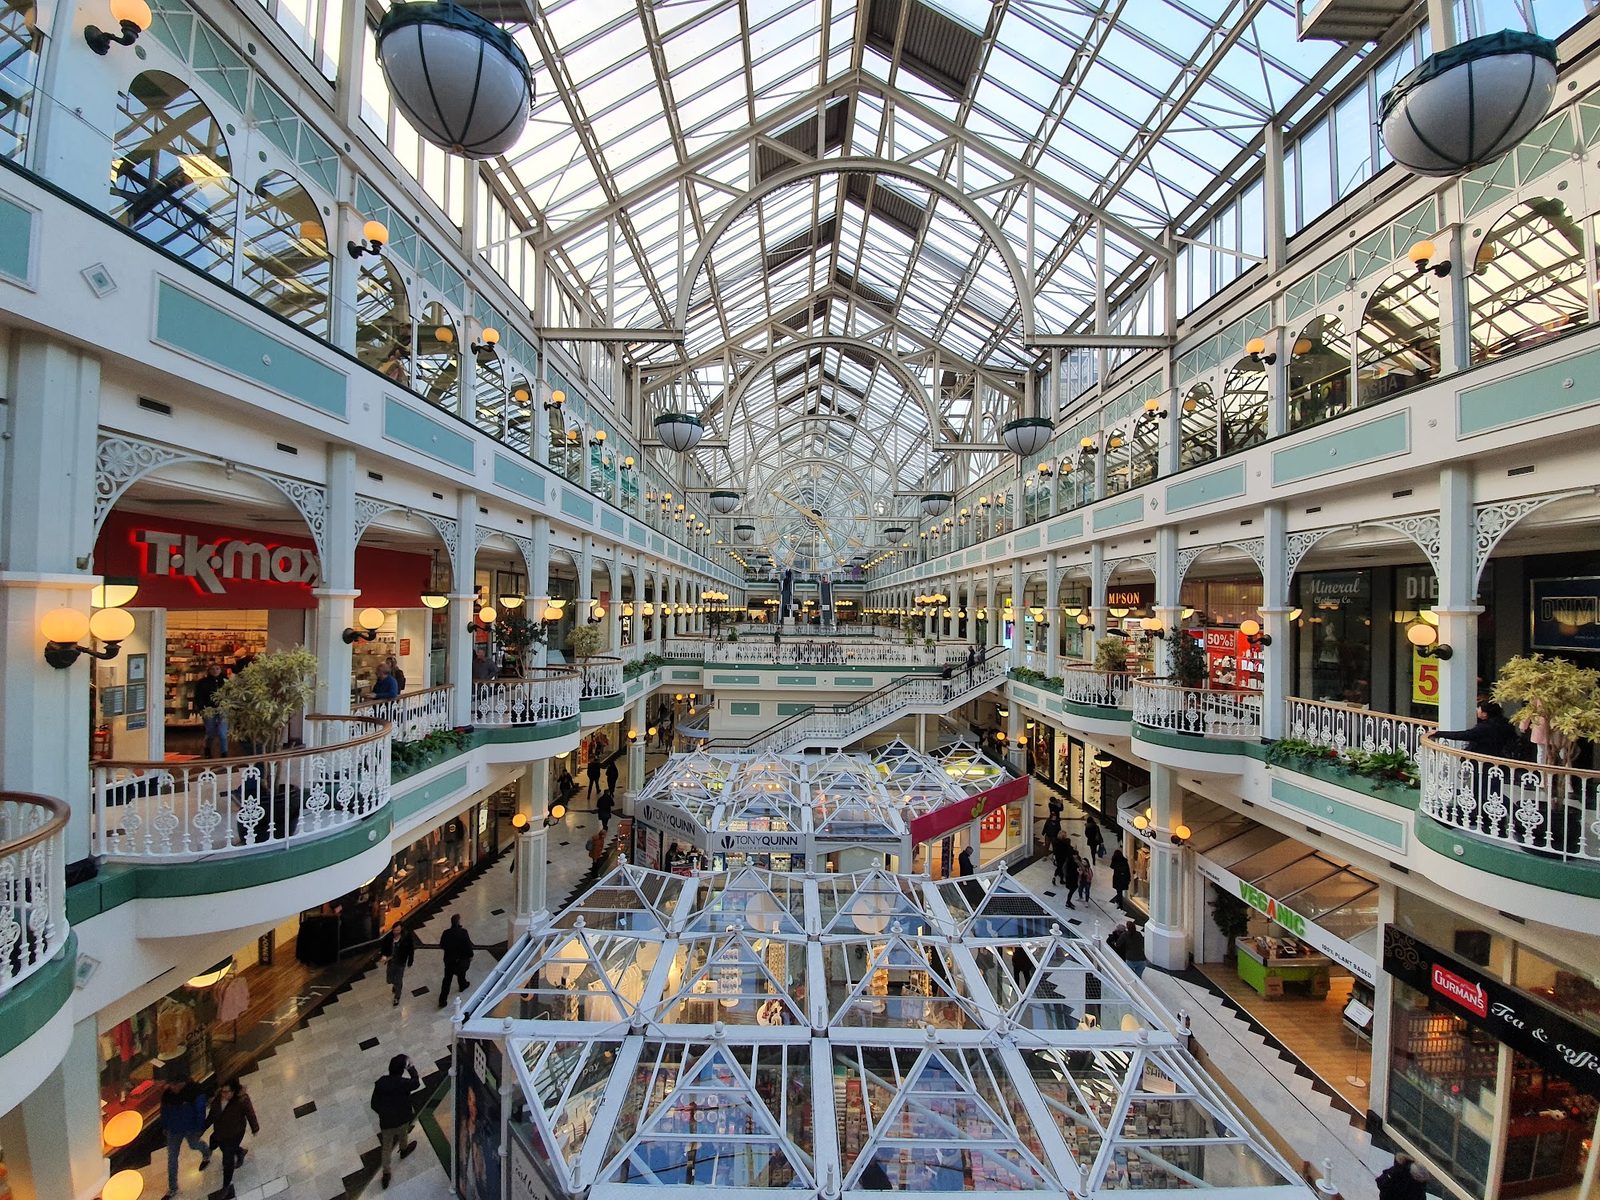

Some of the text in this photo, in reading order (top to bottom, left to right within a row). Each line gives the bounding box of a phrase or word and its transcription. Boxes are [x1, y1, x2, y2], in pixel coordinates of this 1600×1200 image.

[1306, 578, 1360, 594] Mineral
[1207, 633, 1229, 647] 50%
[1239, 879, 1306, 937] VEGANIC
[1334, 952, 1353, 966] PLANT
[1353, 963, 1372, 979] BASED
[1491, 1002, 1525, 1030] Tea
[1532, 1028, 1549, 1044] &
